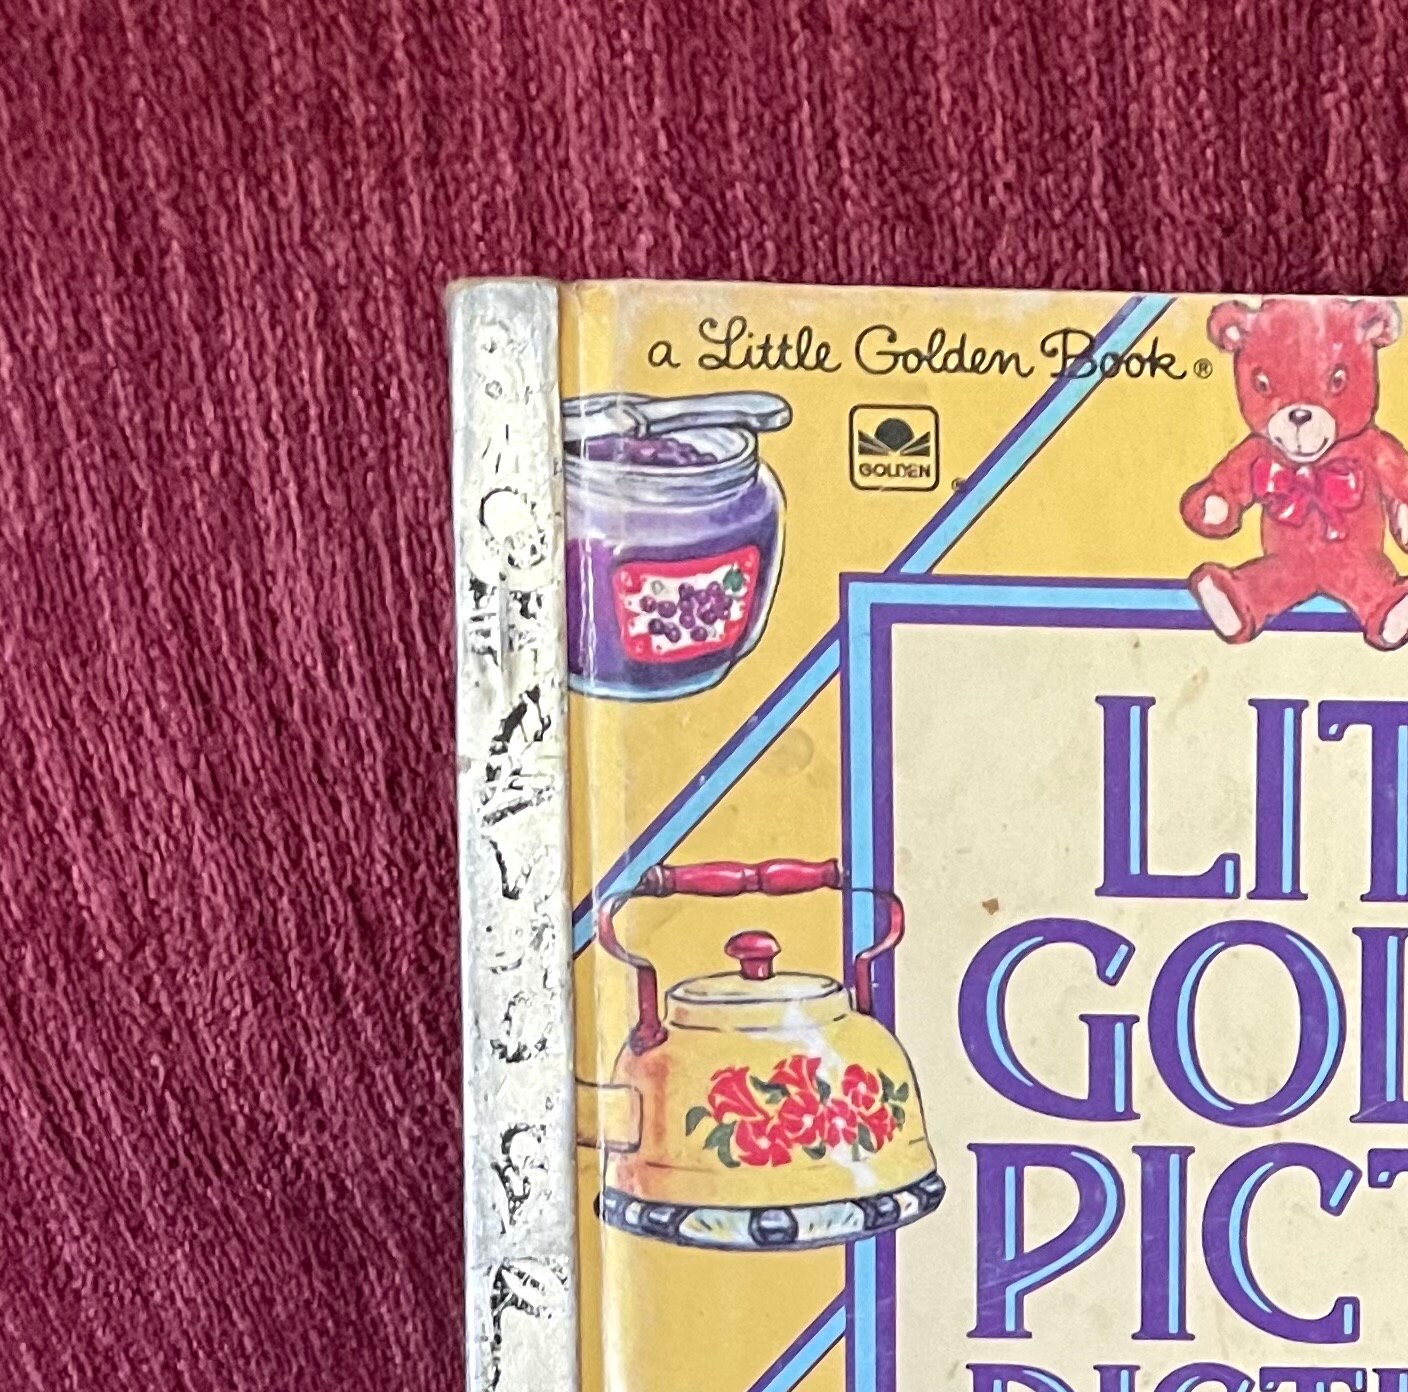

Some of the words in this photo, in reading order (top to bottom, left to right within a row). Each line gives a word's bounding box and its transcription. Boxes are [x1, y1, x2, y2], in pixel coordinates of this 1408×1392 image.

[648, 341, 681, 369] a
[697, 315, 842, 374] Little
[854, 324, 1034, 376] Golden
[858, 462, 931, 478] GOLDEN
